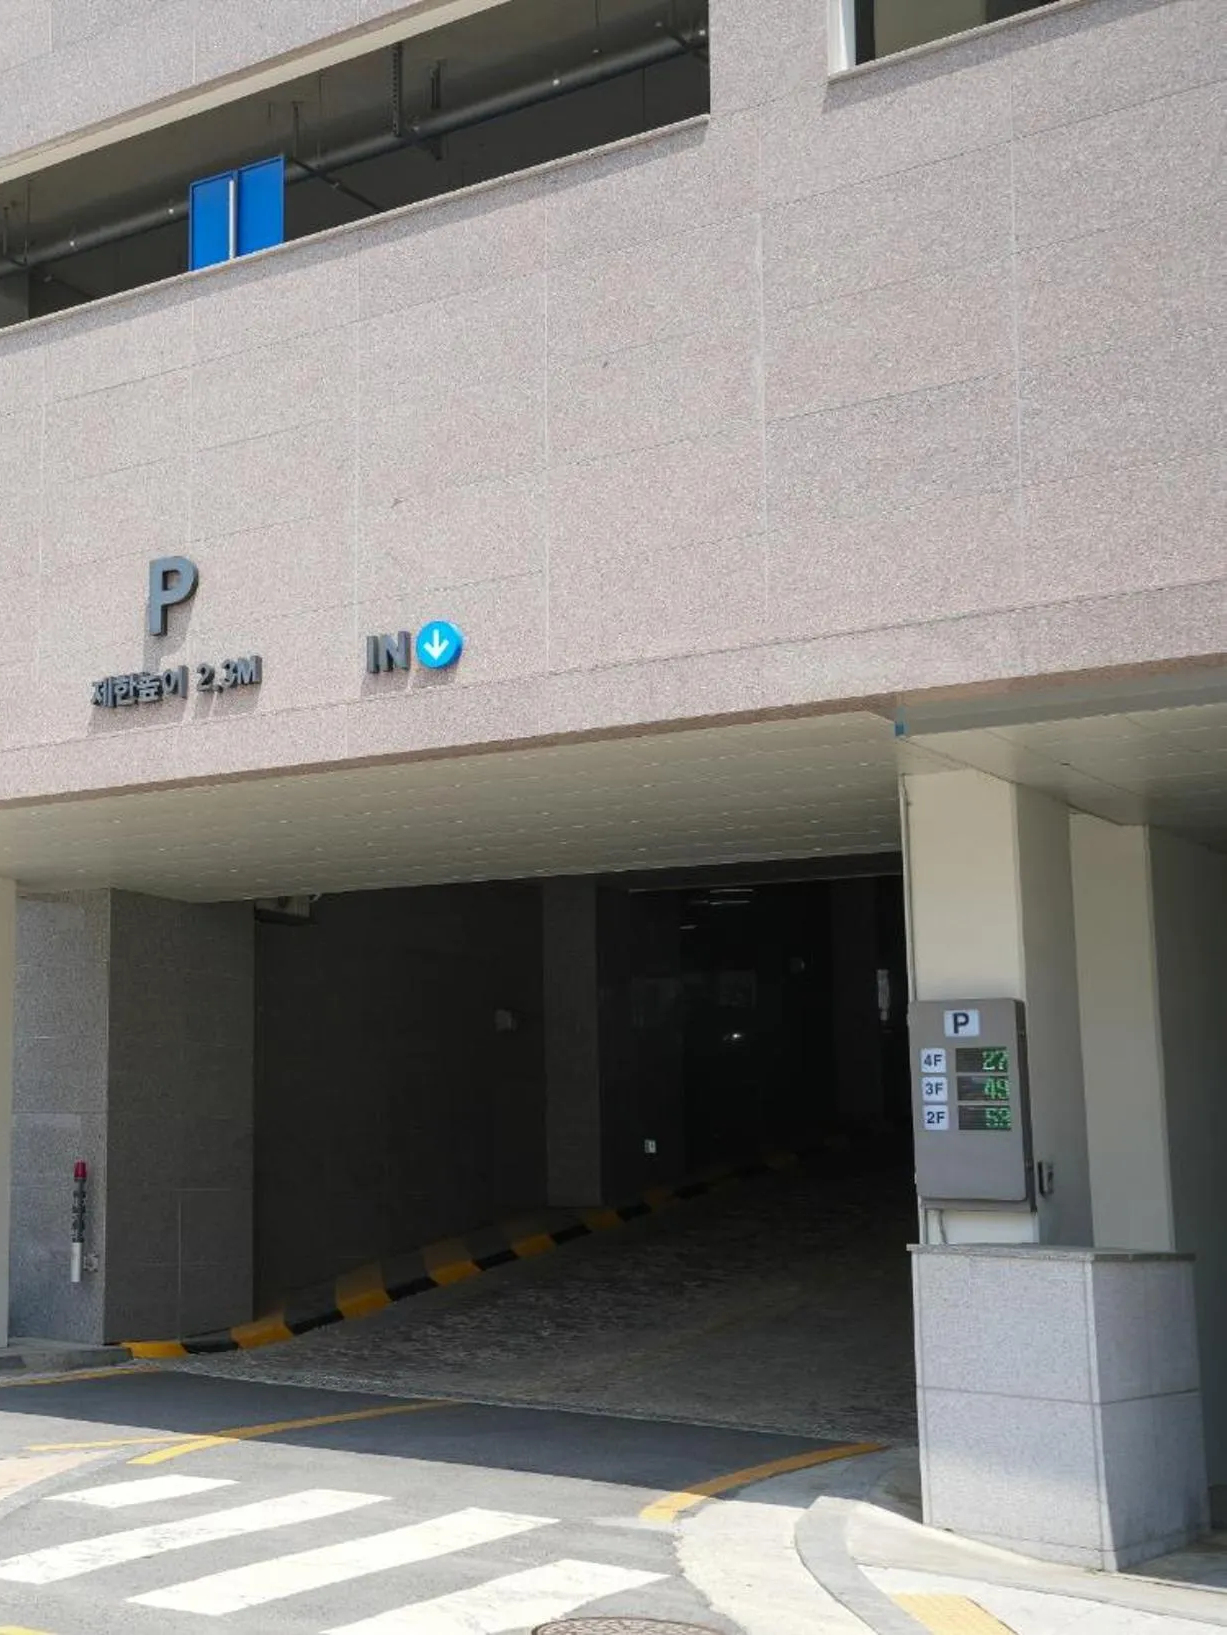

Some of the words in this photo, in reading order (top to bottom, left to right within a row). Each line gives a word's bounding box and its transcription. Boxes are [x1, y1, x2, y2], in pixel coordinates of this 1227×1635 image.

[148, 555, 199, 636] P
[366, 630, 411, 674] IN
[91, 664, 189, 708] 제한높이
[196, 655, 263, 694] 2.3M
[952, 1012, 970, 1034] P
[923, 1053, 943, 1067] 4F
[925, 1082, 944, 1096] 3F
[926, 1110, 946, 1125] 2F
